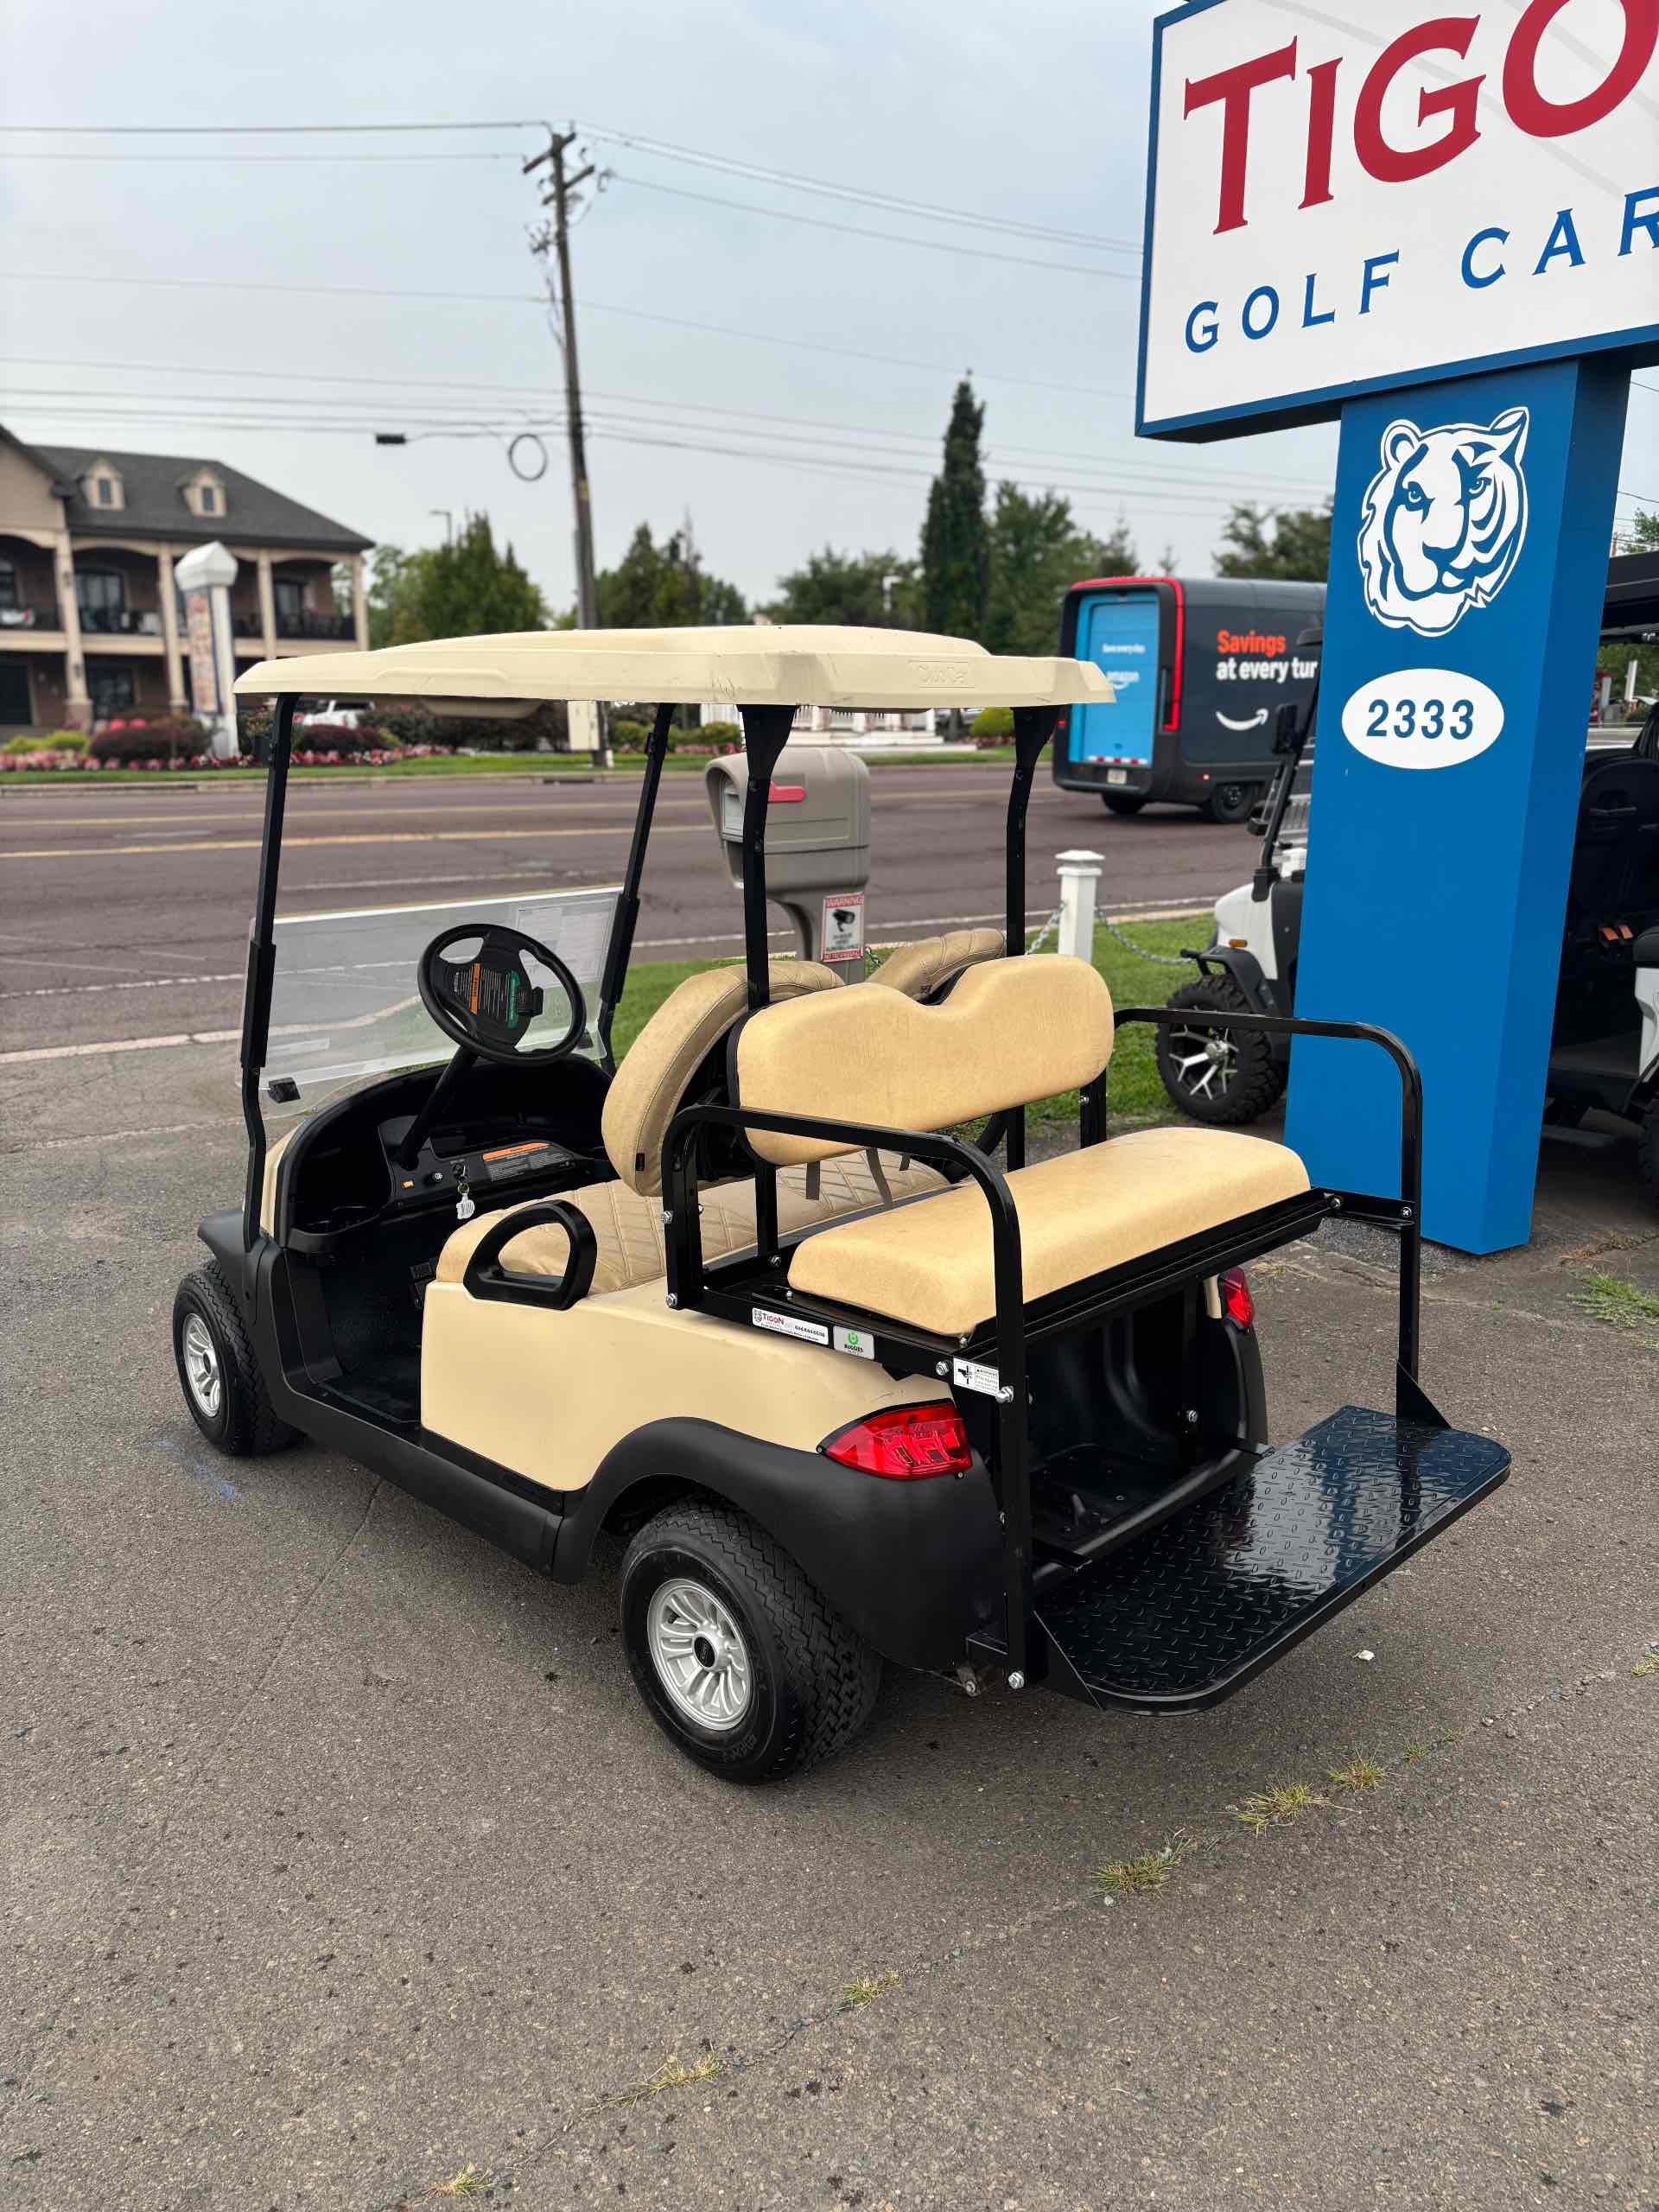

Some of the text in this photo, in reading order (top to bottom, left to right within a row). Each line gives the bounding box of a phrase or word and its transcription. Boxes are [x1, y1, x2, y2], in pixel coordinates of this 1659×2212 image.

[1185, 250, 1400, 353] GOLF
[1217, 629, 1286, 658] Savings
[1217, 658, 1236, 680] at
[1239, 661, 1289, 683] every
[1366, 698, 1474, 741] 2333
[762, 1313, 785, 1325] TIGON
